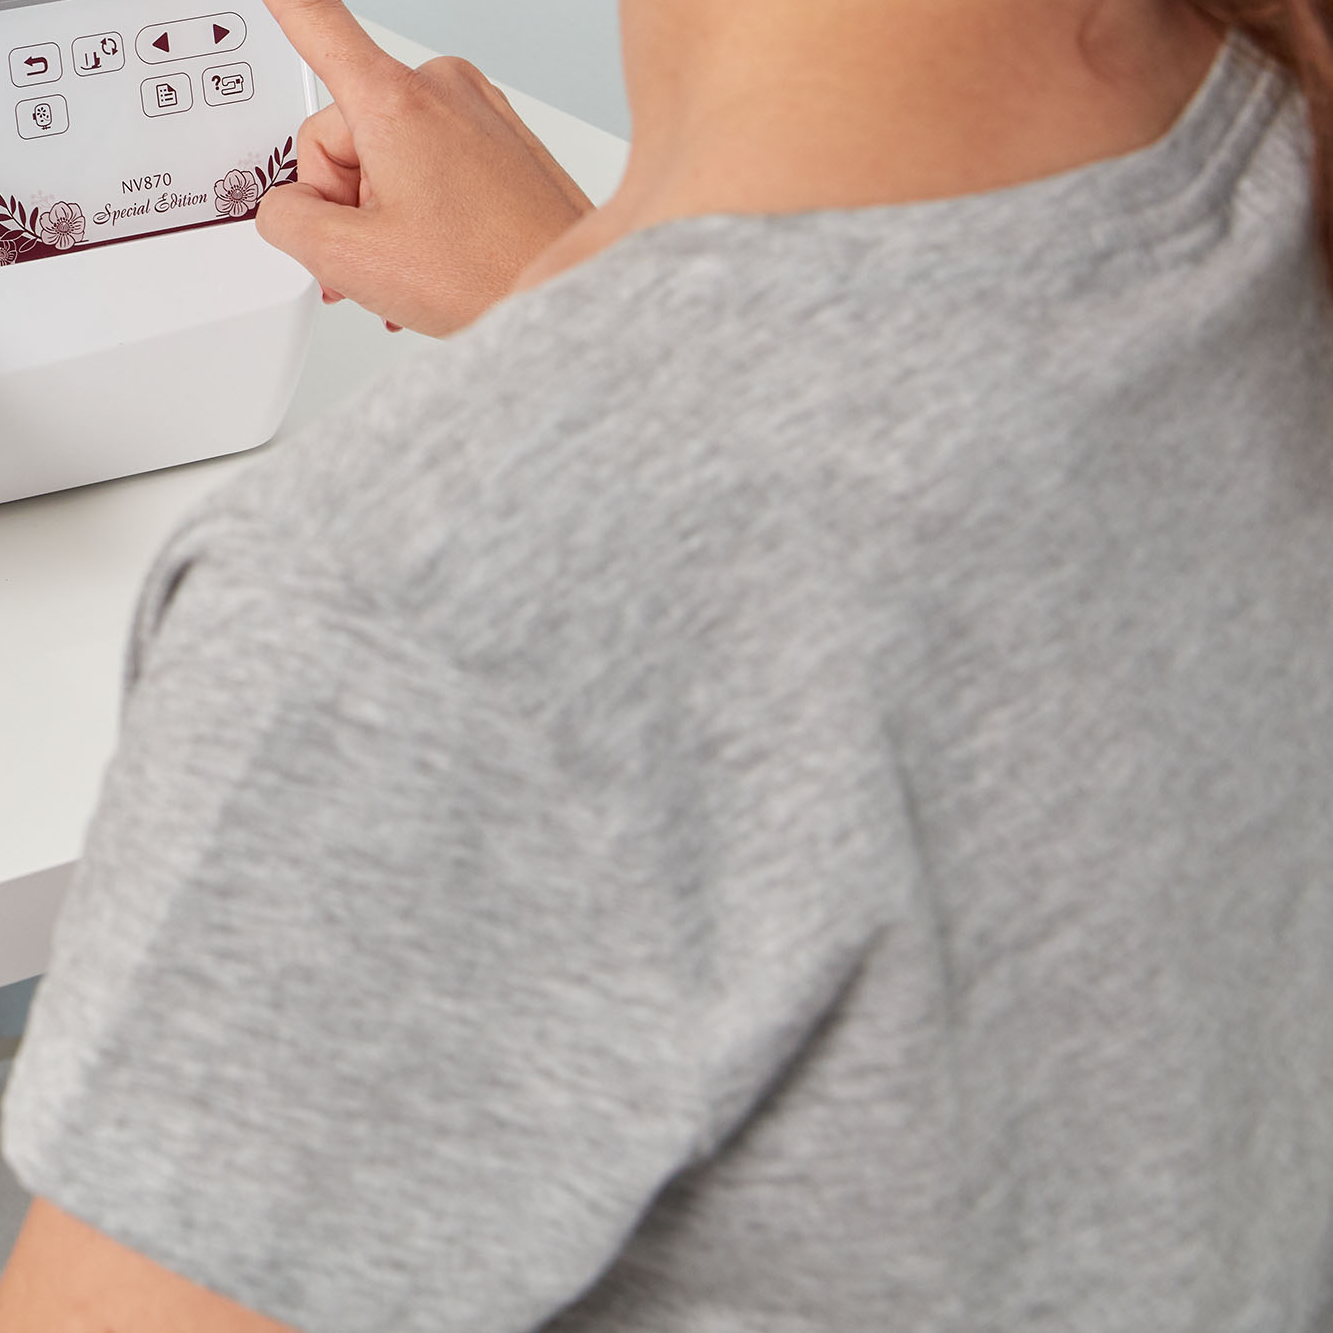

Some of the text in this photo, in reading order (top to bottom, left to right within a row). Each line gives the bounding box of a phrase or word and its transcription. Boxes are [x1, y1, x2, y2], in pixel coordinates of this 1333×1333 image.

[121, 172, 172, 194] NV870
[93, 192, 207, 226] Special Edition
